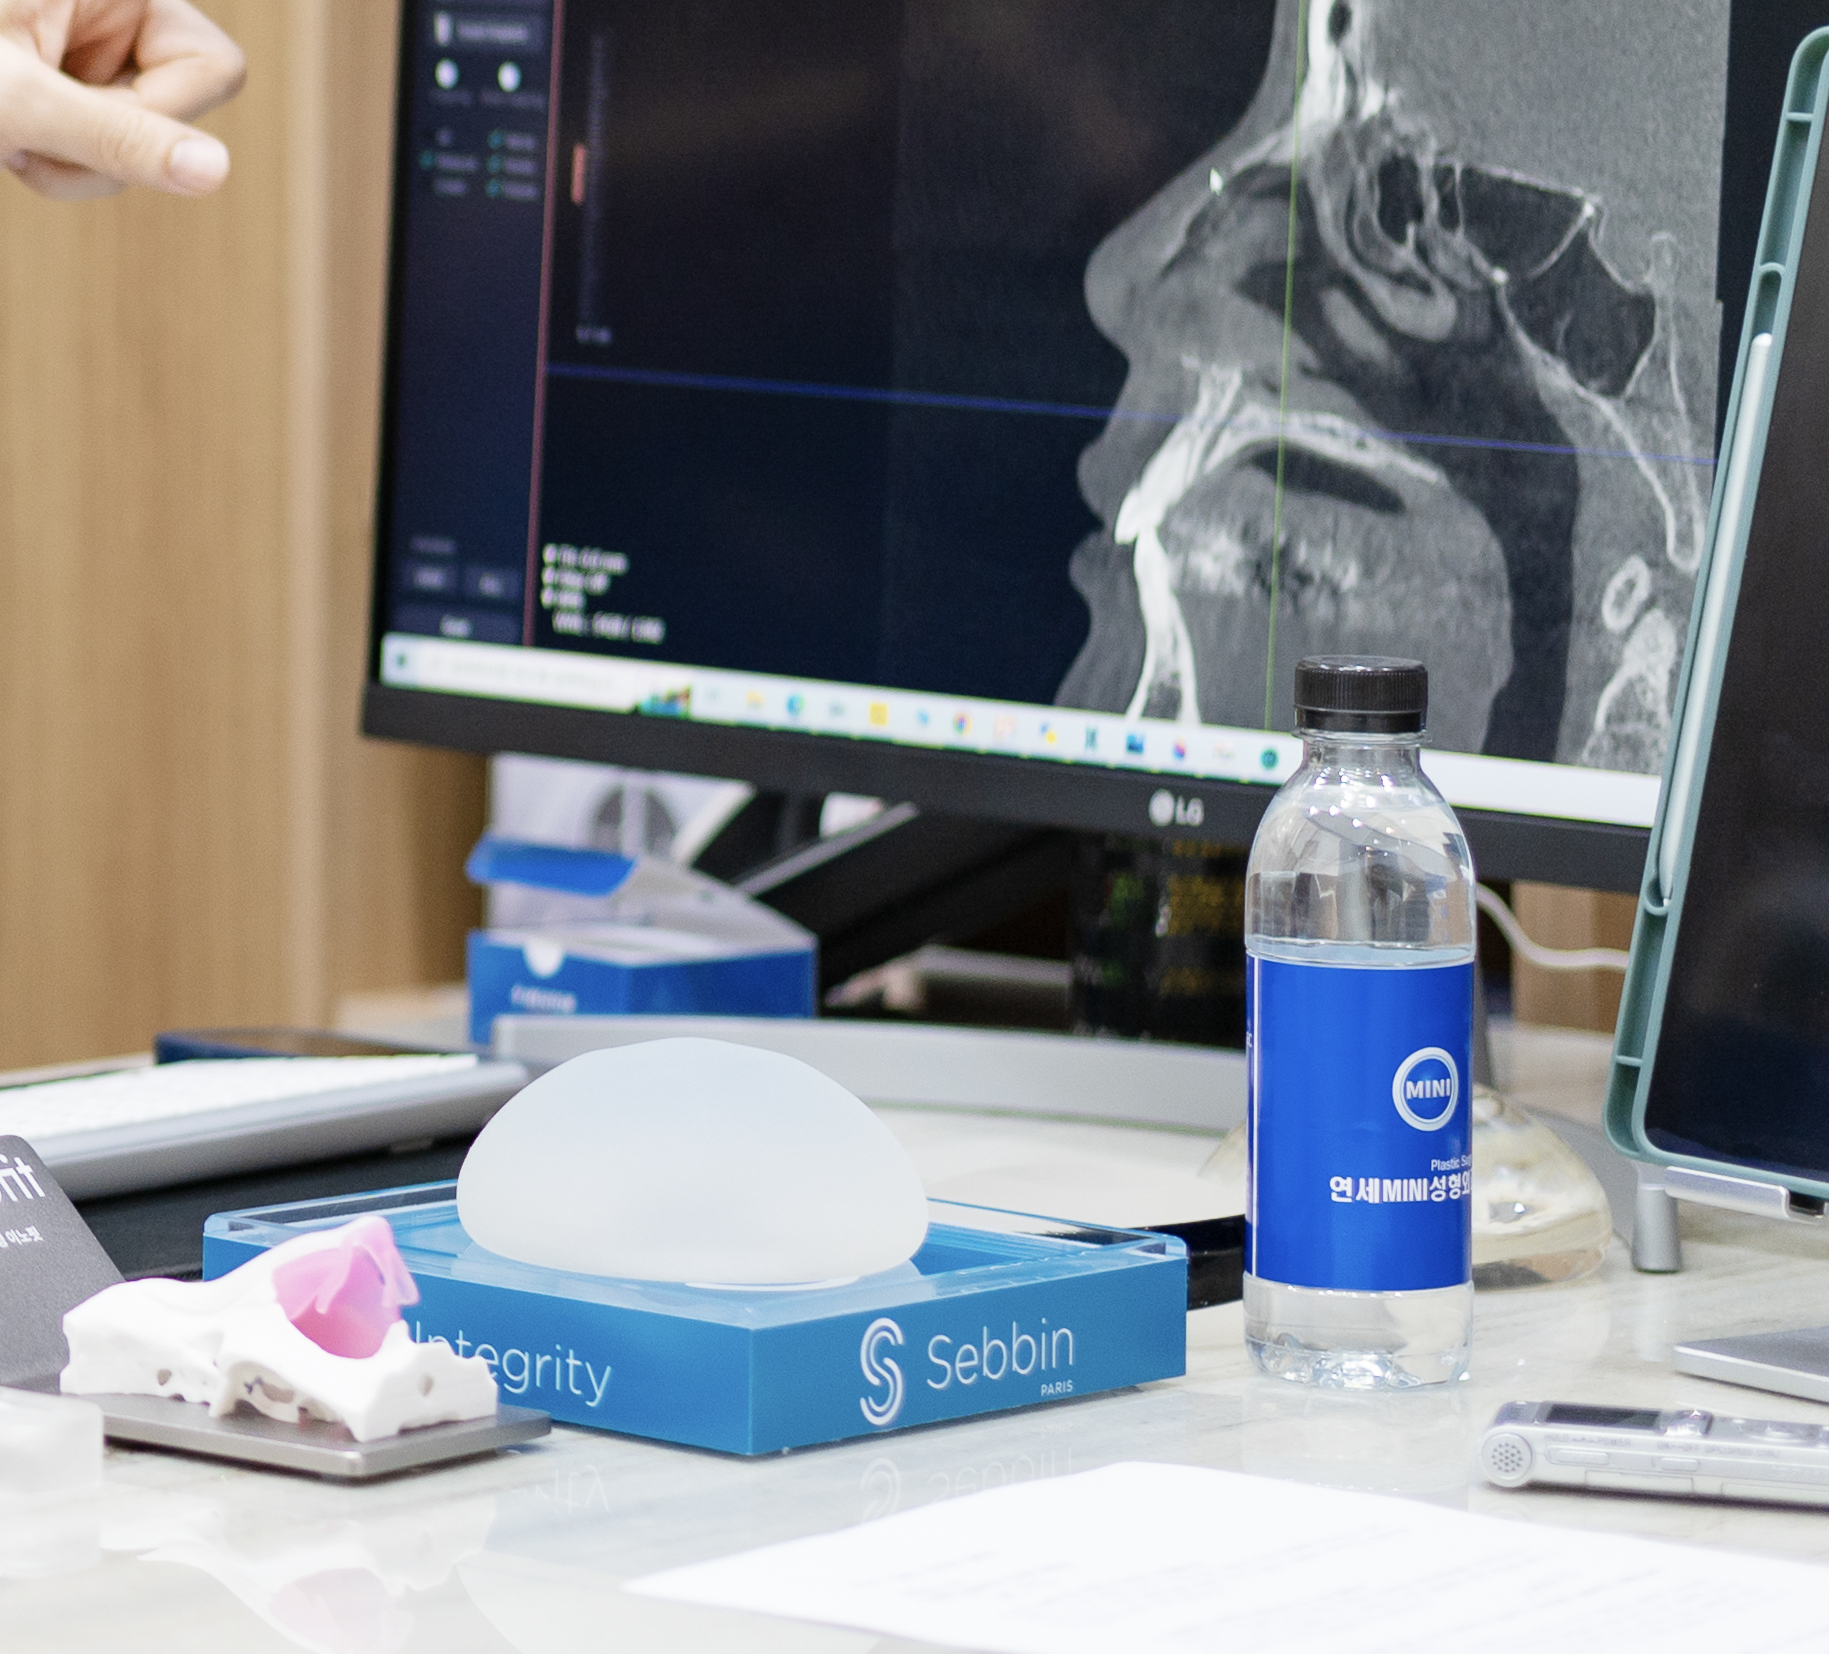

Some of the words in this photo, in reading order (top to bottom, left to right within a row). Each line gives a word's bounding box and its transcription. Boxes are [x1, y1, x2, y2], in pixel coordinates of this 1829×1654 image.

[1175, 795, 1204, 826] LG
[1406, 1078, 1451, 1100] MINI
[1430, 1157, 1460, 1171] Plastic
[1329, 1171, 1472, 1204] 연세MINI성형외
[415, 1321, 611, 1407] Itegrity
[926, 1317, 1075, 1390] Sebbin
[1041, 1379, 1074, 1396] PARIS
